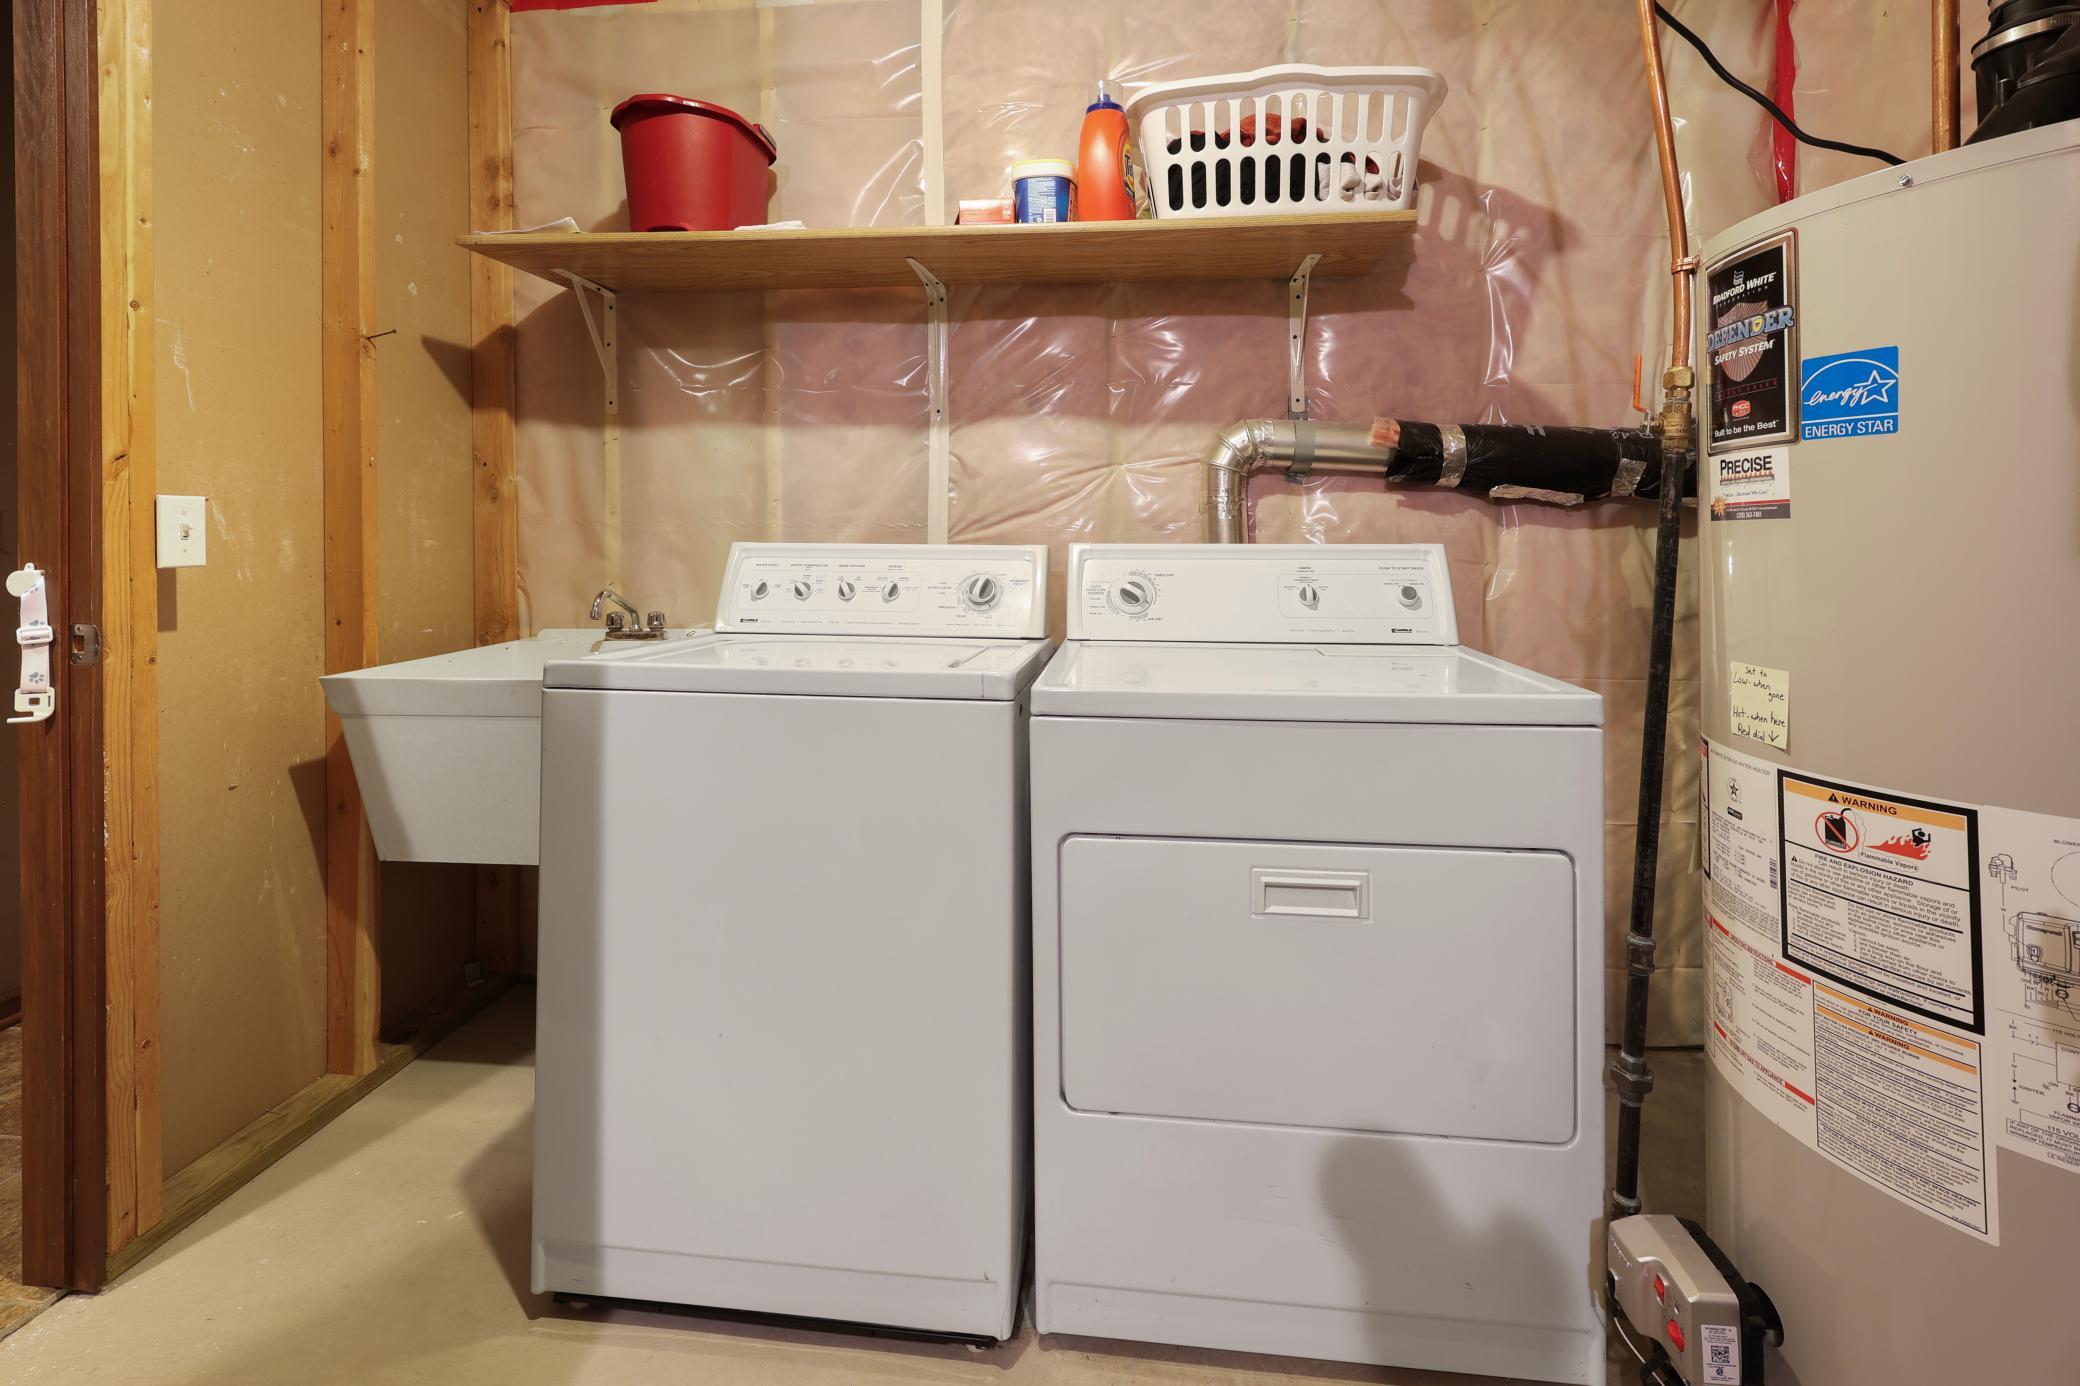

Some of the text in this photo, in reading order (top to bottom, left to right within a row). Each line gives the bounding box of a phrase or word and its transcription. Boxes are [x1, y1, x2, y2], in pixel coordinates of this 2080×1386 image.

[1713, 284, 1745, 305] BRADFORD
[1708, 306, 1794, 352] DEFENDER
[1714, 341, 1774, 366] SAFETY SYSTEM
[1804, 386, 1864, 407] energy
[1743, 424, 1755, 432] the
[1806, 419, 1893, 438] ENERGY STAR
[1720, 455, 1772, 476] PRECISE
[1746, 666, 1768, 677] Set to
[1754, 680, 1770, 690] when
[1768, 692, 1784, 702] gone
[1751, 711, 1768, 723] when
[1738, 723, 1765, 742] Red dial
[1842, 795, 1896, 815] WARNING
[1814, 853, 1913, 886] FIRE AND EXPLOSION HAZARD
[1860, 851, 1917, 872] Flammable Vapors
[1874, 1008, 1907, 1026] WARNING
[1874, 1031, 1908, 1050] WARNING
[2048, 1125, 2060, 1133] 115
